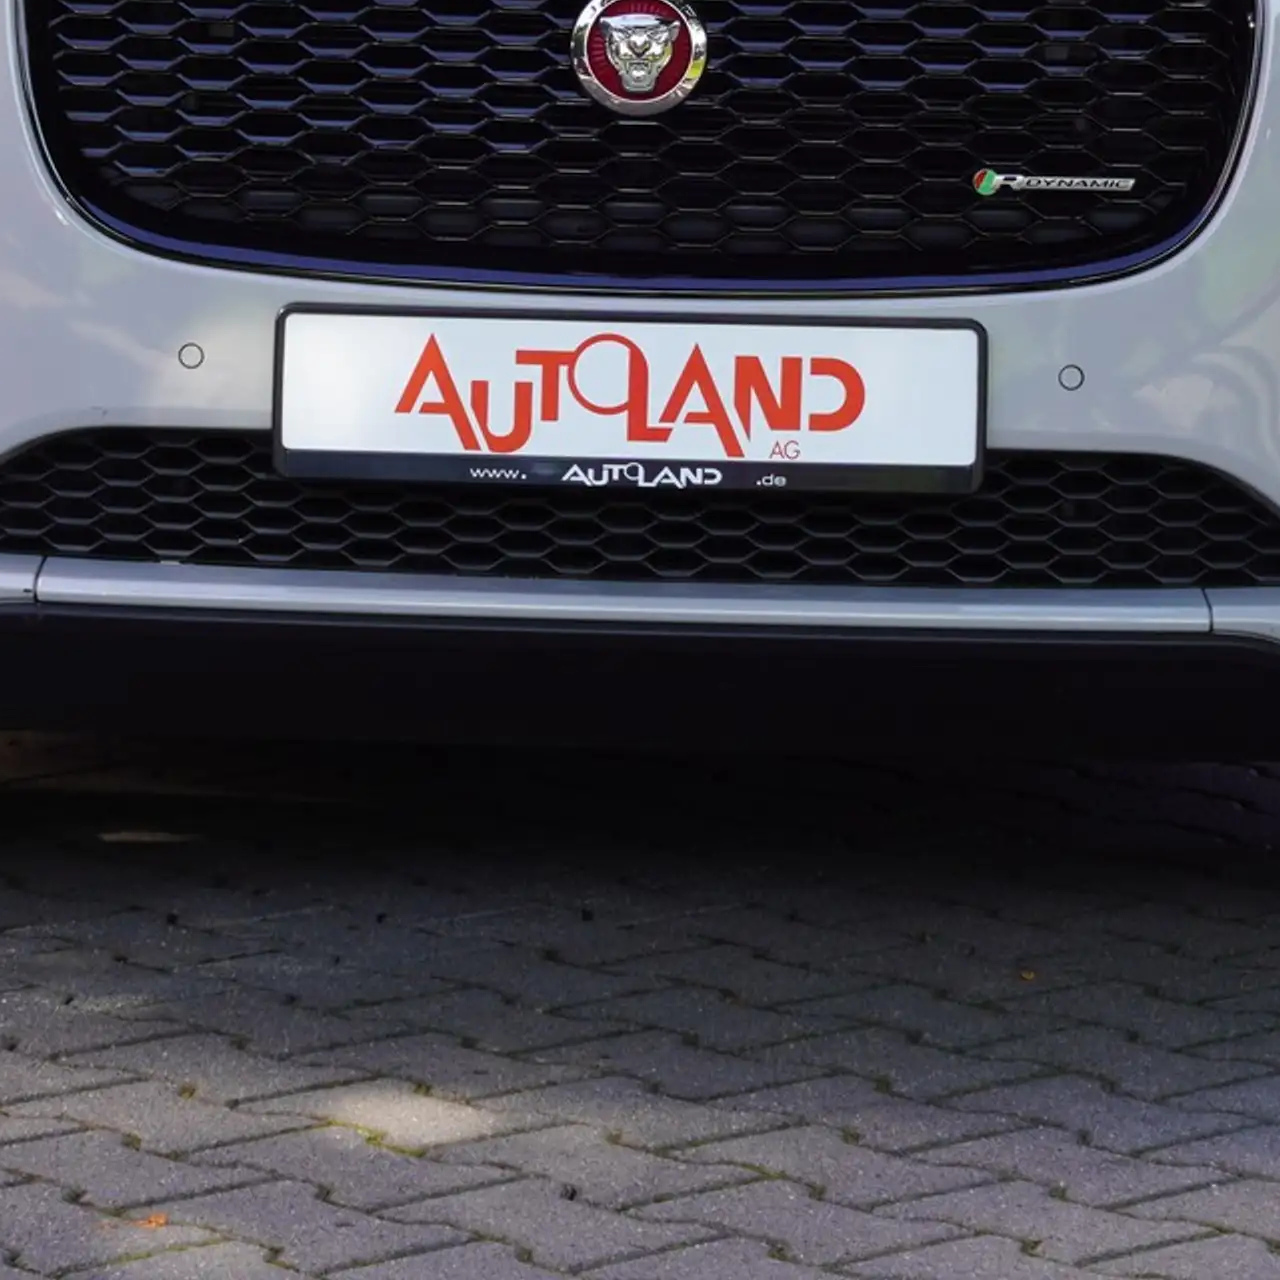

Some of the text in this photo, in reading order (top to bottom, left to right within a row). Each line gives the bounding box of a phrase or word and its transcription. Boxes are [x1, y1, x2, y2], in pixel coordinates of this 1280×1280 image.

[394, 333, 866, 458] AUTOLAND
[769, 439, 802, 460] AG
[470, 467, 527, 480] www.
[756, 473, 788, 487] .de
